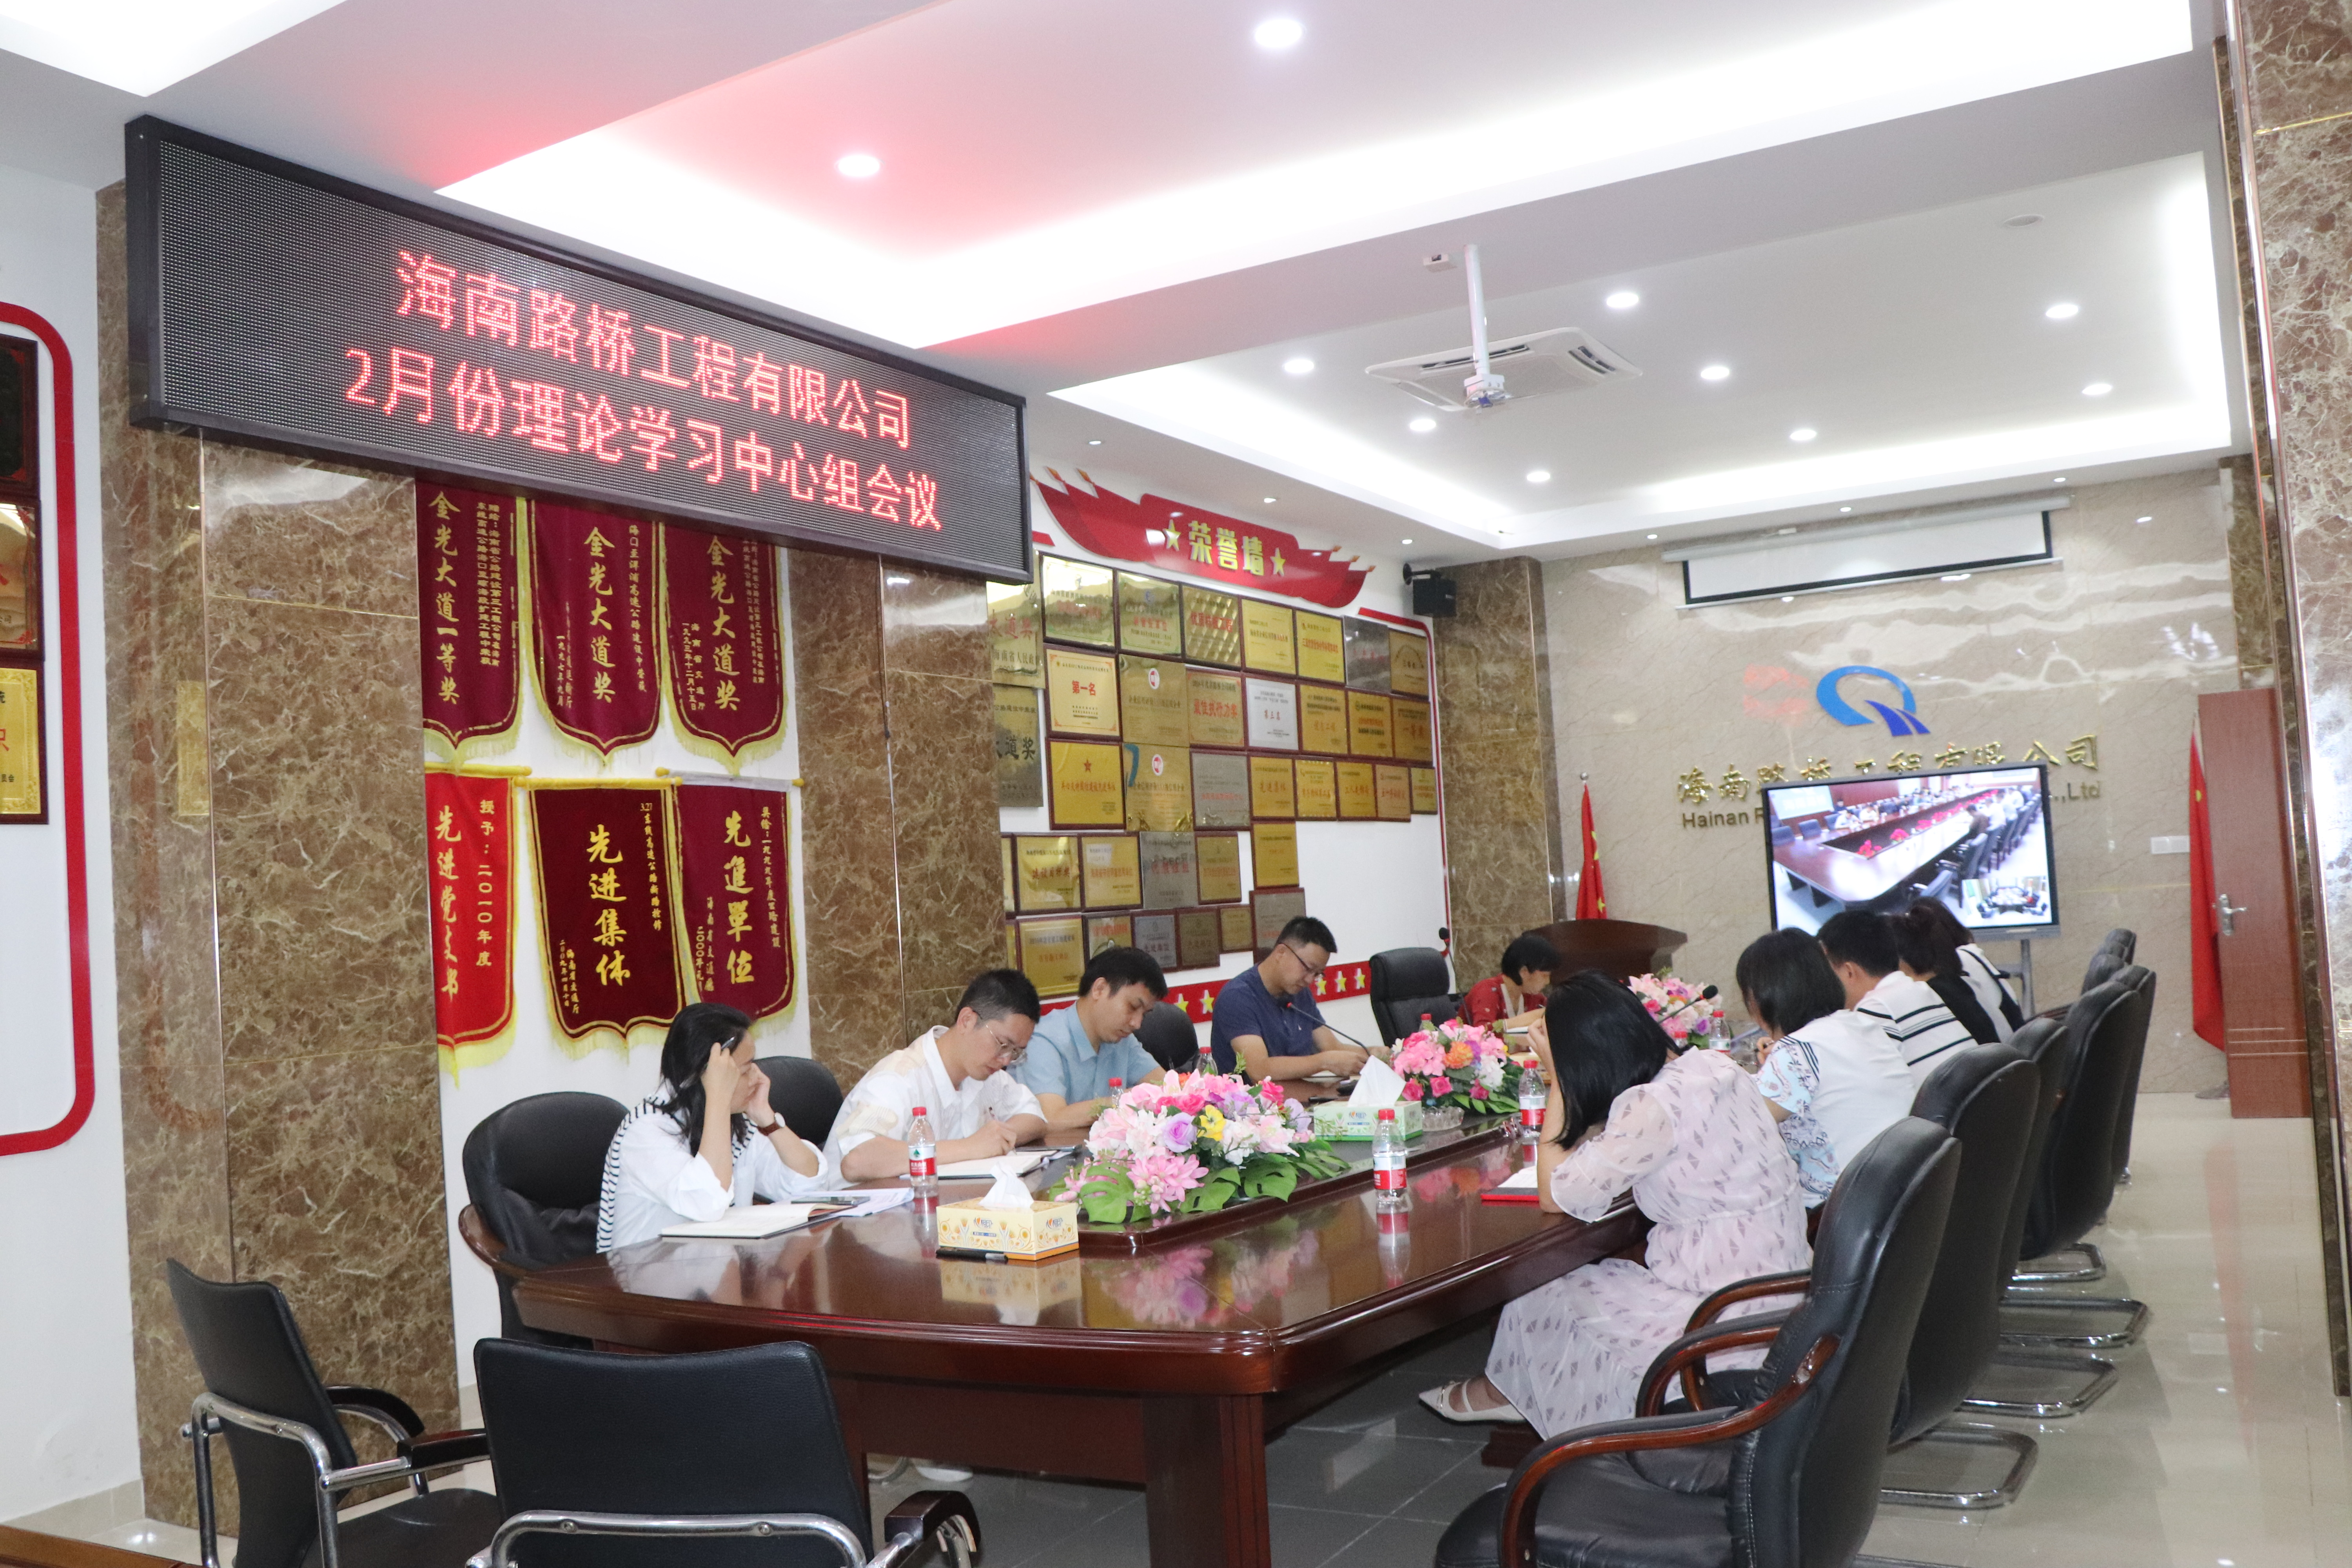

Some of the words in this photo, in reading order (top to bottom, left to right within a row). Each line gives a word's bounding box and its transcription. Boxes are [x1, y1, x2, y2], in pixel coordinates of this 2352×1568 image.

[396, 250, 911, 450] 海南路桥工程有限公司
[345, 347, 943, 532] 2月份理论学习中心组会议
[430, 491, 461, 704] 金光大道一等奖
[584, 526, 616, 703] 金光大道奖
[707, 535, 740, 711] 金光大道奖
[1188, 520, 1265, 576] 荣誉墙
[1072, 680, 1096, 696] 第一名
[586, 824, 630, 986] 先进集体
[724, 810, 754, 984] 先進單位
[1682, 809, 1749, 828] Hainan
